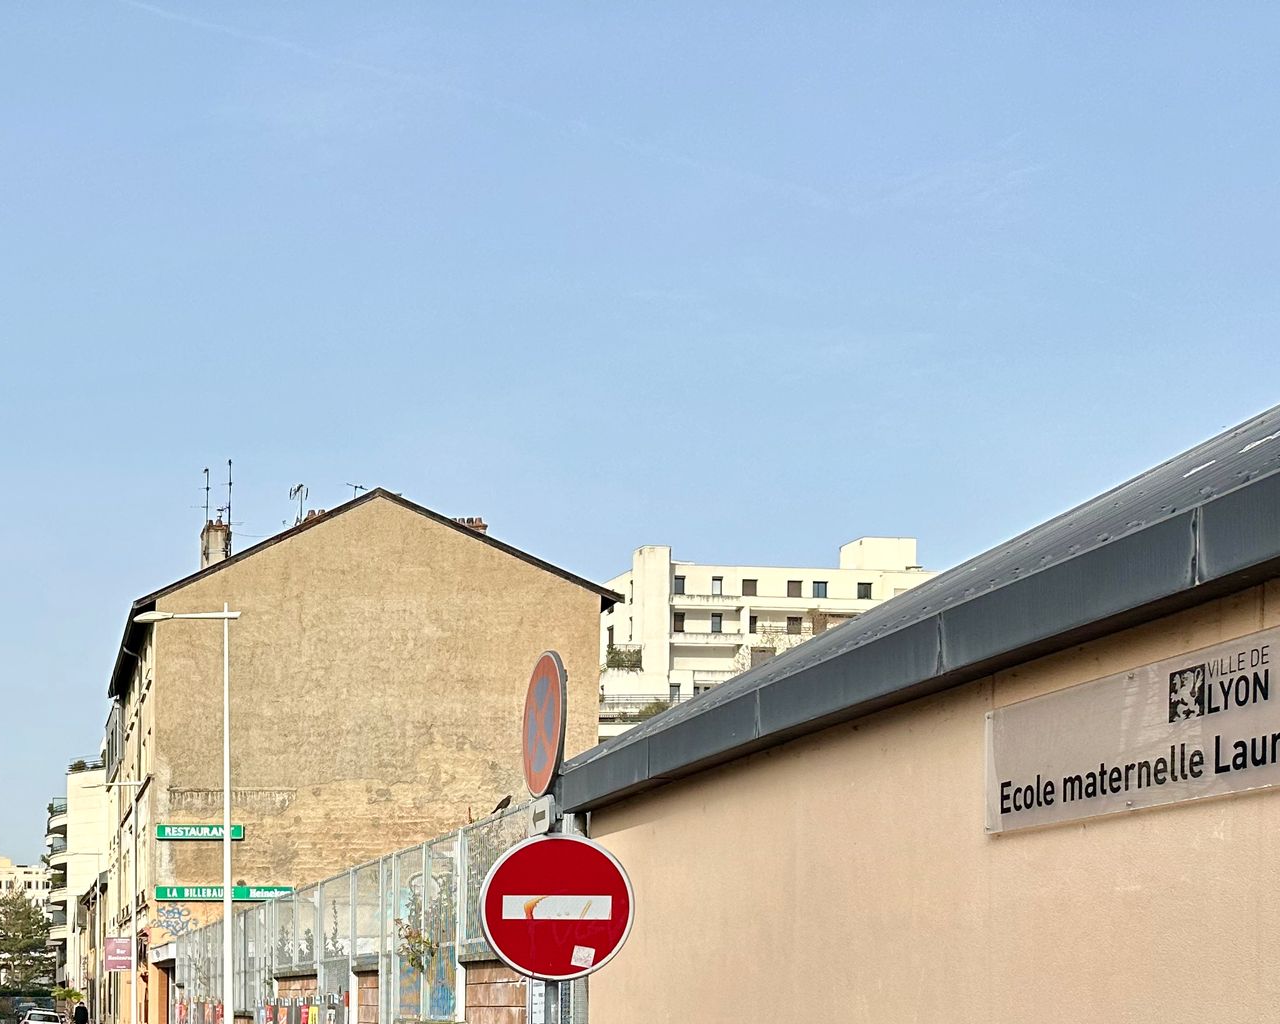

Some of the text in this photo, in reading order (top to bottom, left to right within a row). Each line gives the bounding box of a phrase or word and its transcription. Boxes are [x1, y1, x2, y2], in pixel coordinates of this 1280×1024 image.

[1206, 644, 1270, 679] VILLE DE
[1207, 668, 1269, 714] LYON
[1000, 774, 1055, 815] Ecole
[1062, 743, 1205, 803] maternelle
[167, 887, 235, 898] LA BILLEBAUE
